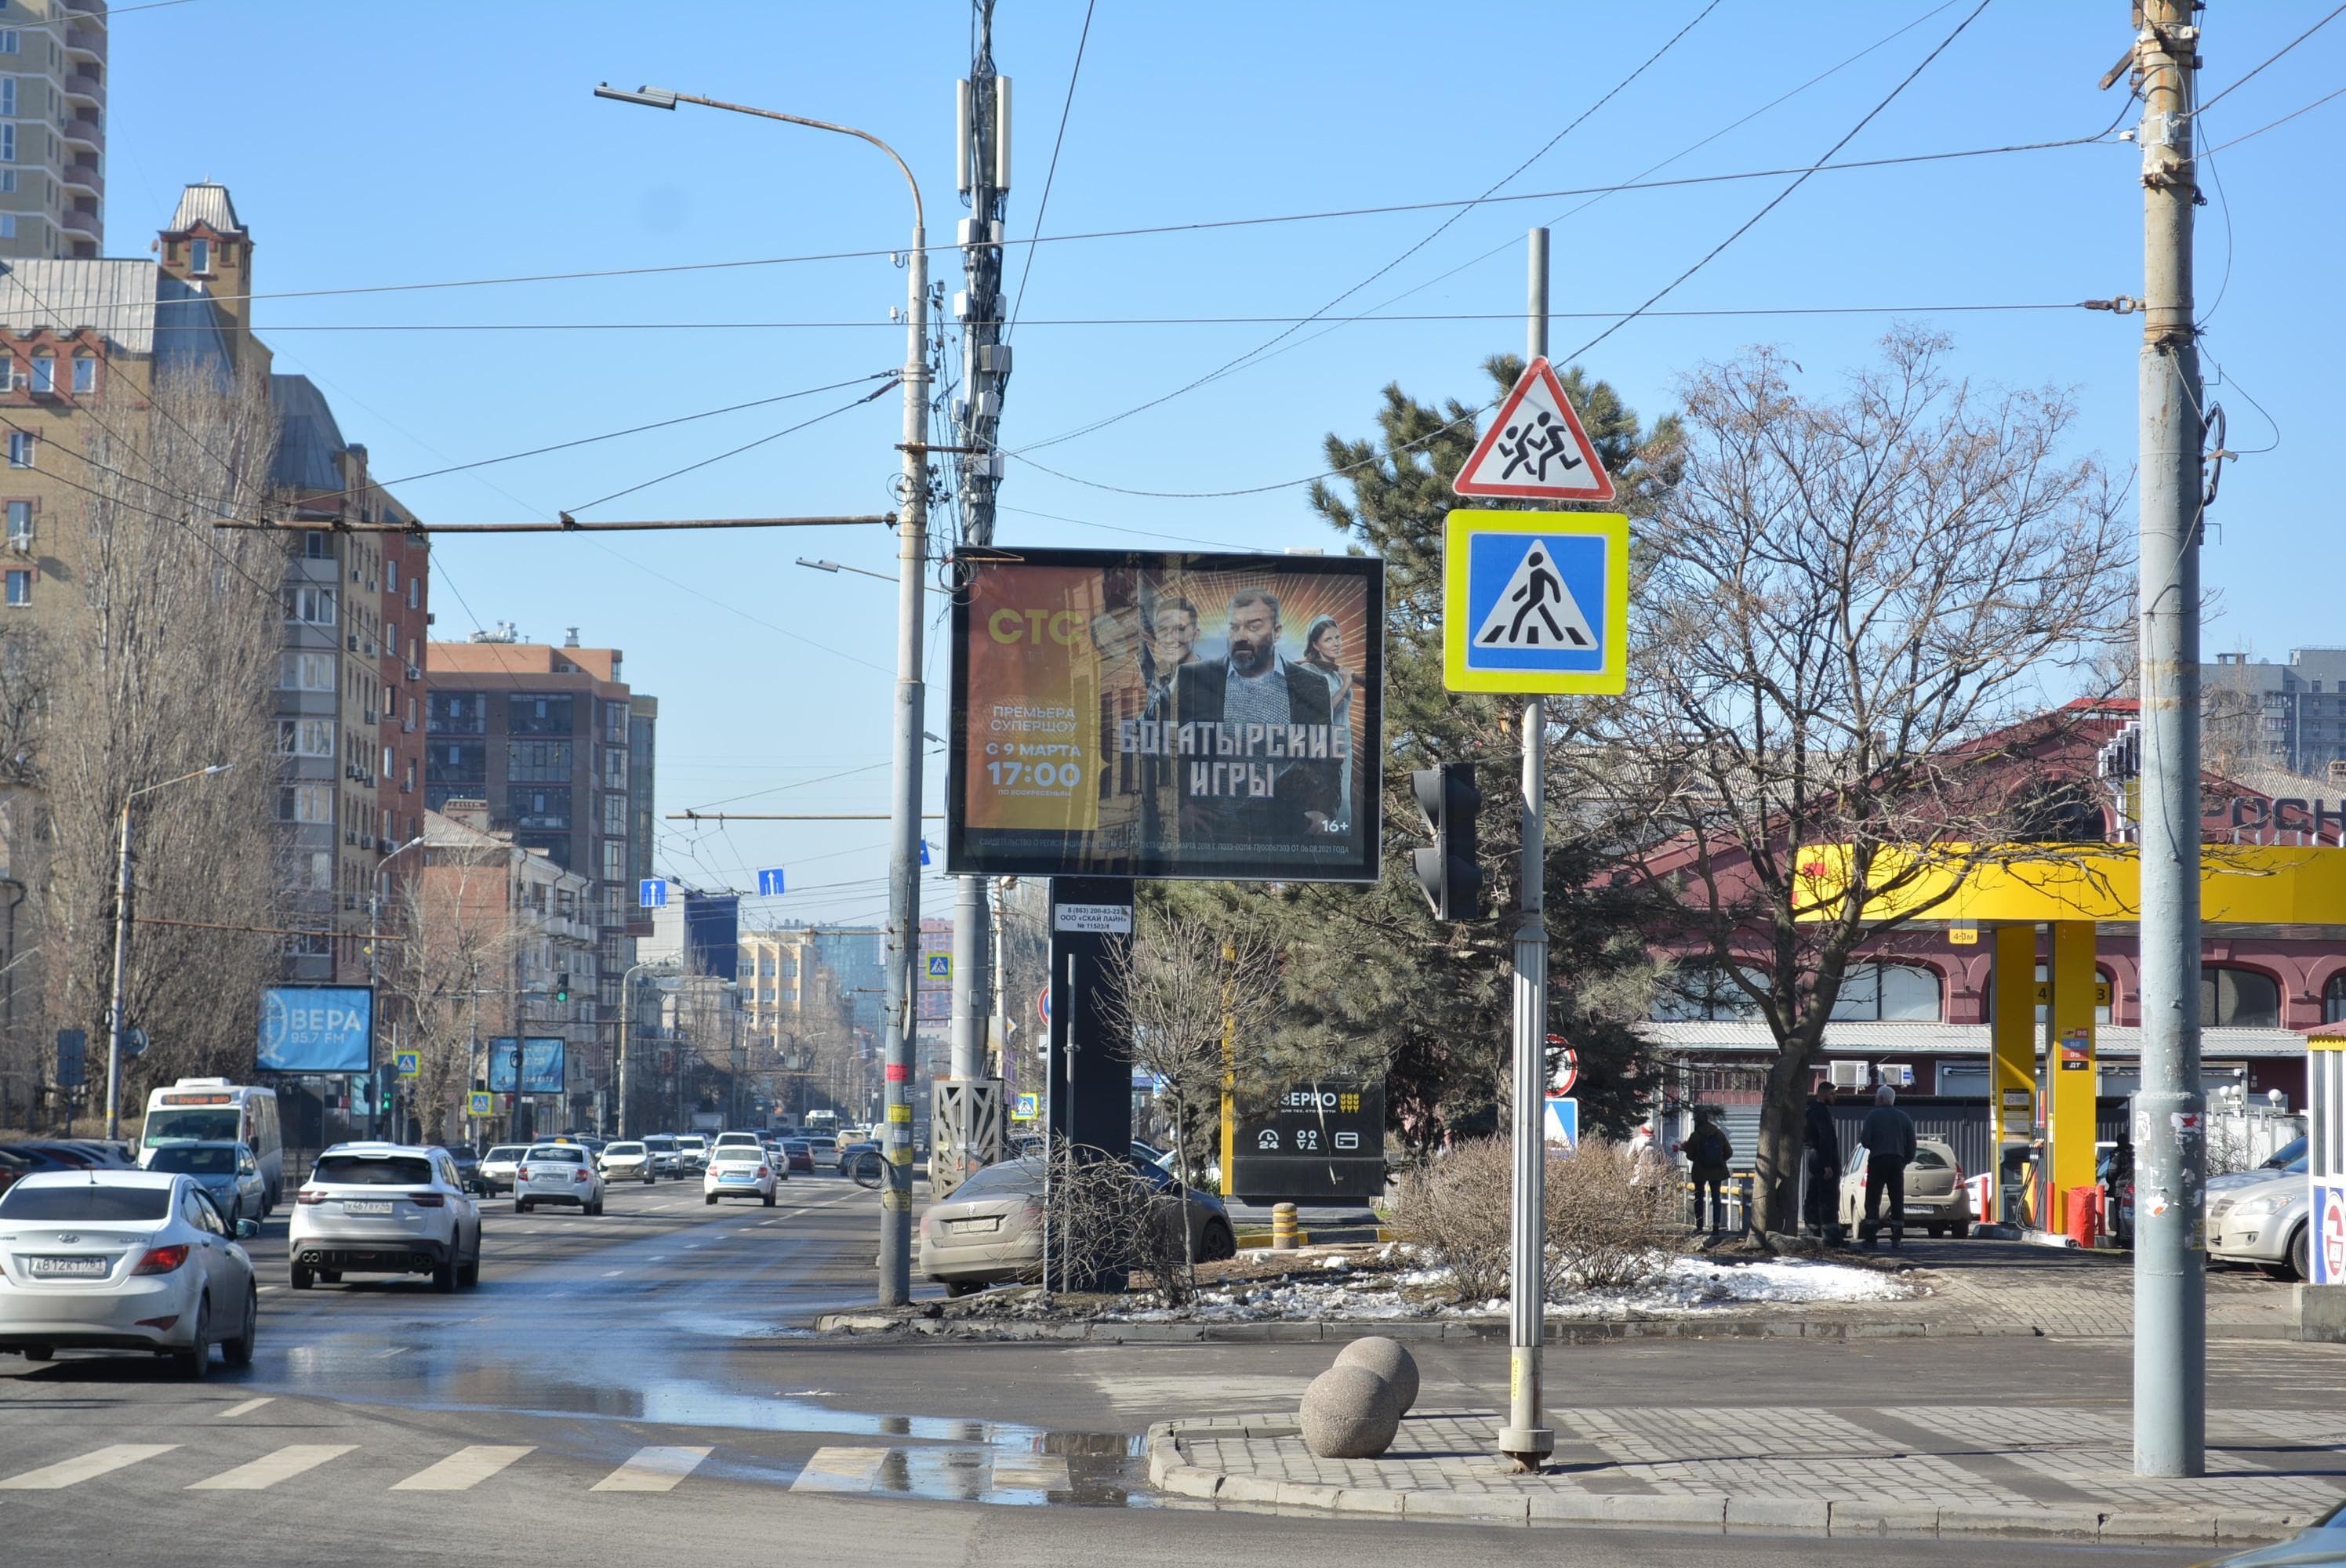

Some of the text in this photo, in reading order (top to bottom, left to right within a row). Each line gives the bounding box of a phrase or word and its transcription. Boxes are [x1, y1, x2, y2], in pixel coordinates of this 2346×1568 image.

[988, 608, 1084, 644] СТС
[993, 706, 1076, 719] ПРЕМЬЕРА
[990, 719, 1078, 732] СУПЕРШОУ
[1119, 719, 1347, 759] БОГАТЫРСКИЕ
[986, 742, 1081, 757] С 9 МАРТА
[986, 761, 1080, 787] 17:00
[1189, 761, 1275, 798] ИГРЫ
[1321, 819, 1349, 833] 16+
[1333, 844, 1350, 854] ГОДА
[2038, 989, 2048, 1000] 4
[2096, 989, 2106, 1000] 3
[291, 1009, 361, 1032] ВЕРА
[291, 1032, 345, 1044] 95.7 FM
[1280, 1092, 1337, 1106] ЗЕРНО
[1258, 1141, 1279, 1149] 24
